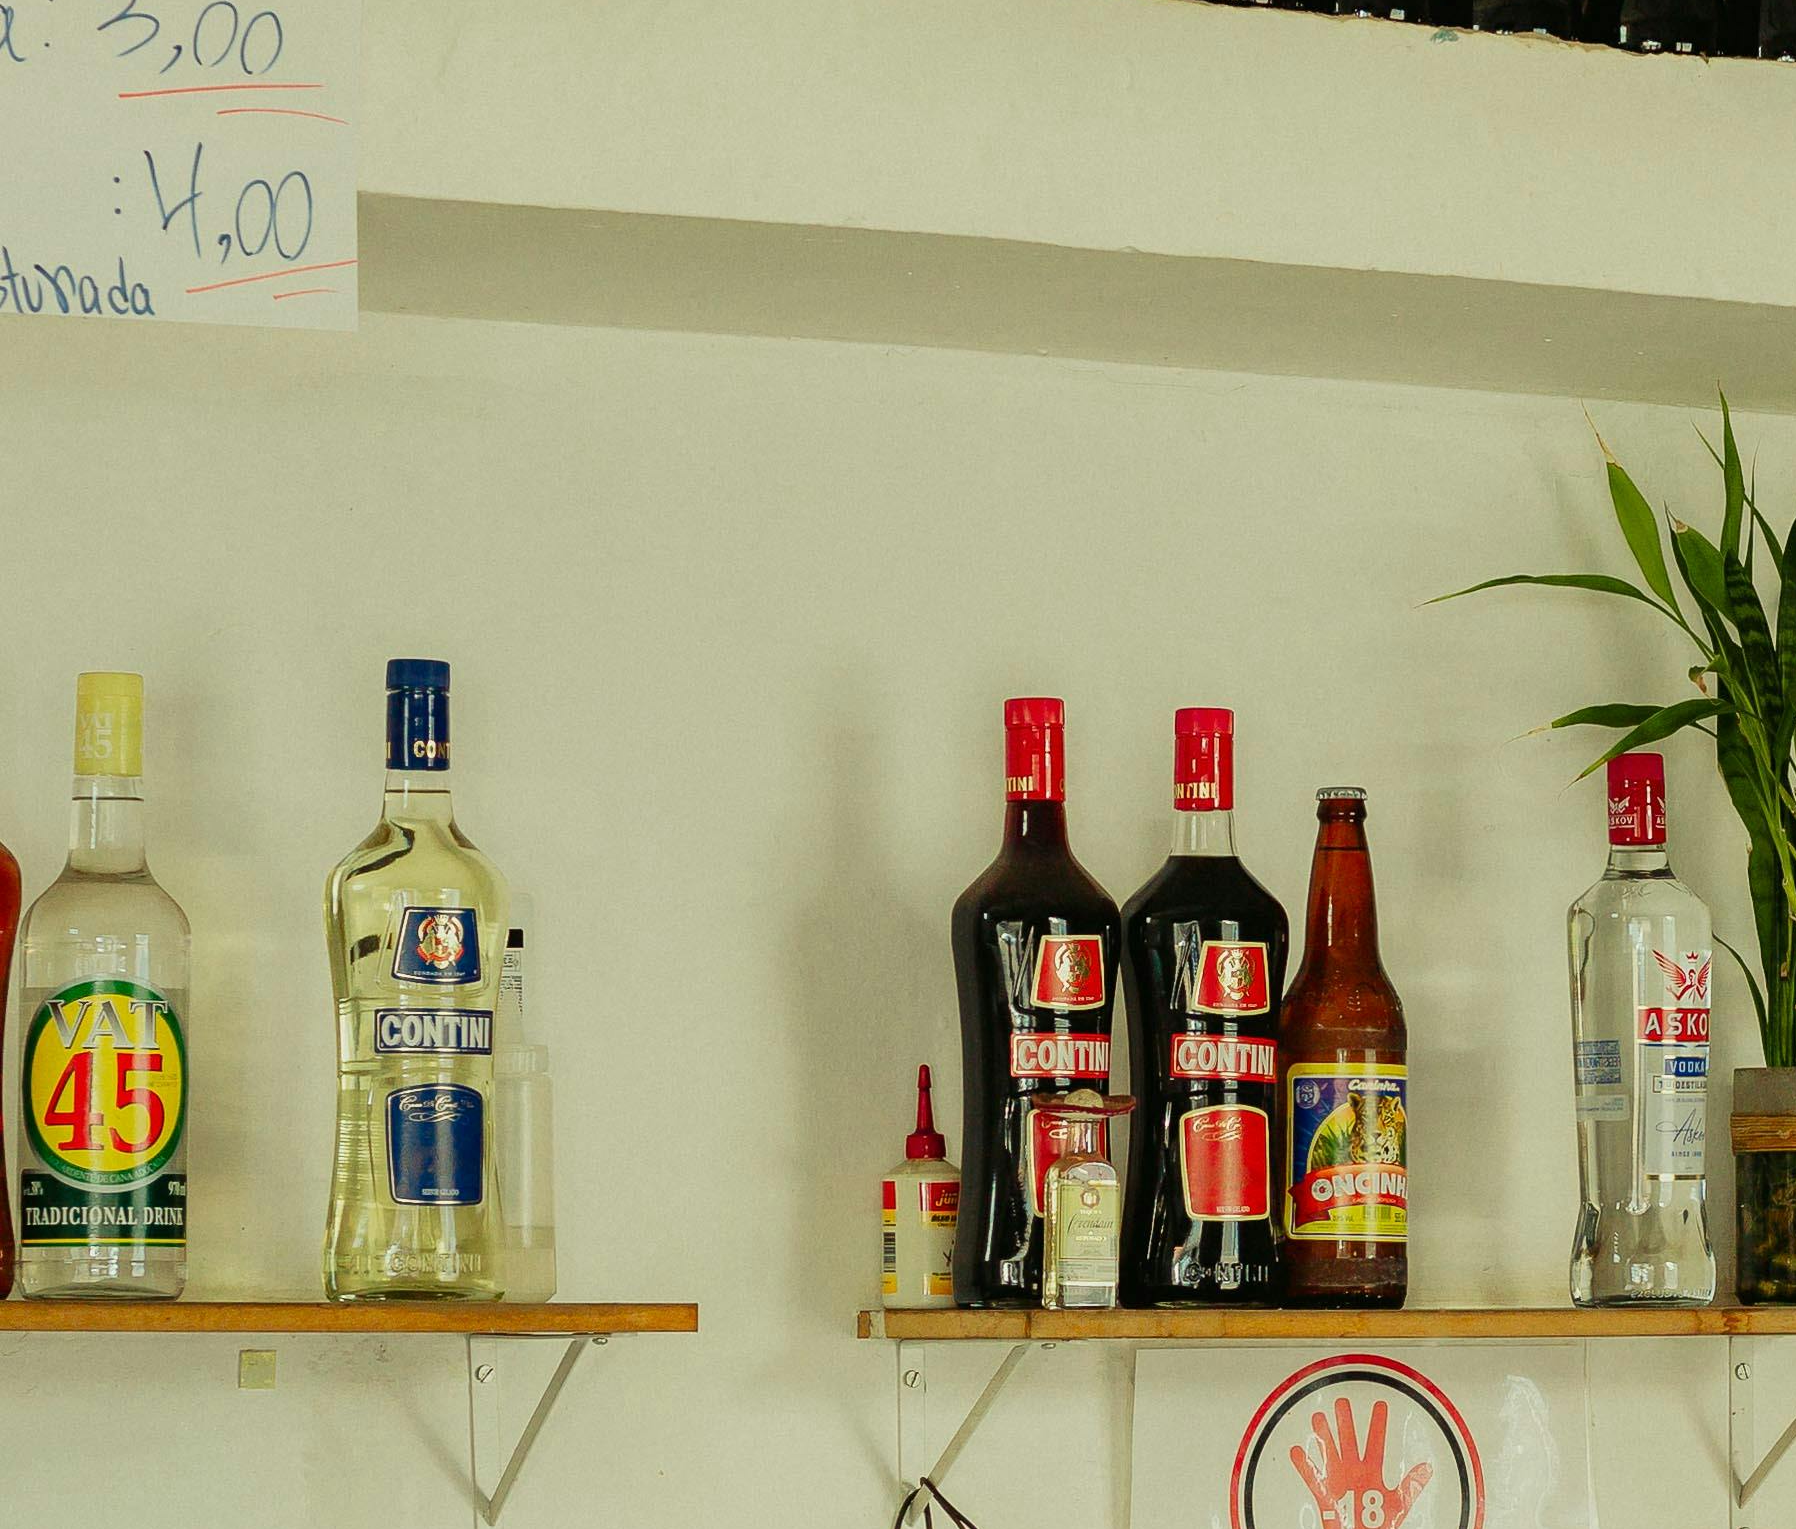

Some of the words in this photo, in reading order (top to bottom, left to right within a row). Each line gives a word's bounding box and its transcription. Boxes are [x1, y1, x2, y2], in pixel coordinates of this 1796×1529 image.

[144, 142, 313, 265] 4,00
[46, 999, 168, 1050] VAT
[380, 1015, 490, 1049] CONTINI
[1018, 1040, 1109, 1072] CONTINI
[1178, 1041, 1275, 1076] CONTINI
[43, 1050, 166, 1154] 45
[26, 1206, 138, 1226] TRADICIONAL
[143, 1206, 184, 1226] DRINK
[1322, 1489, 1386, 1529] -18
